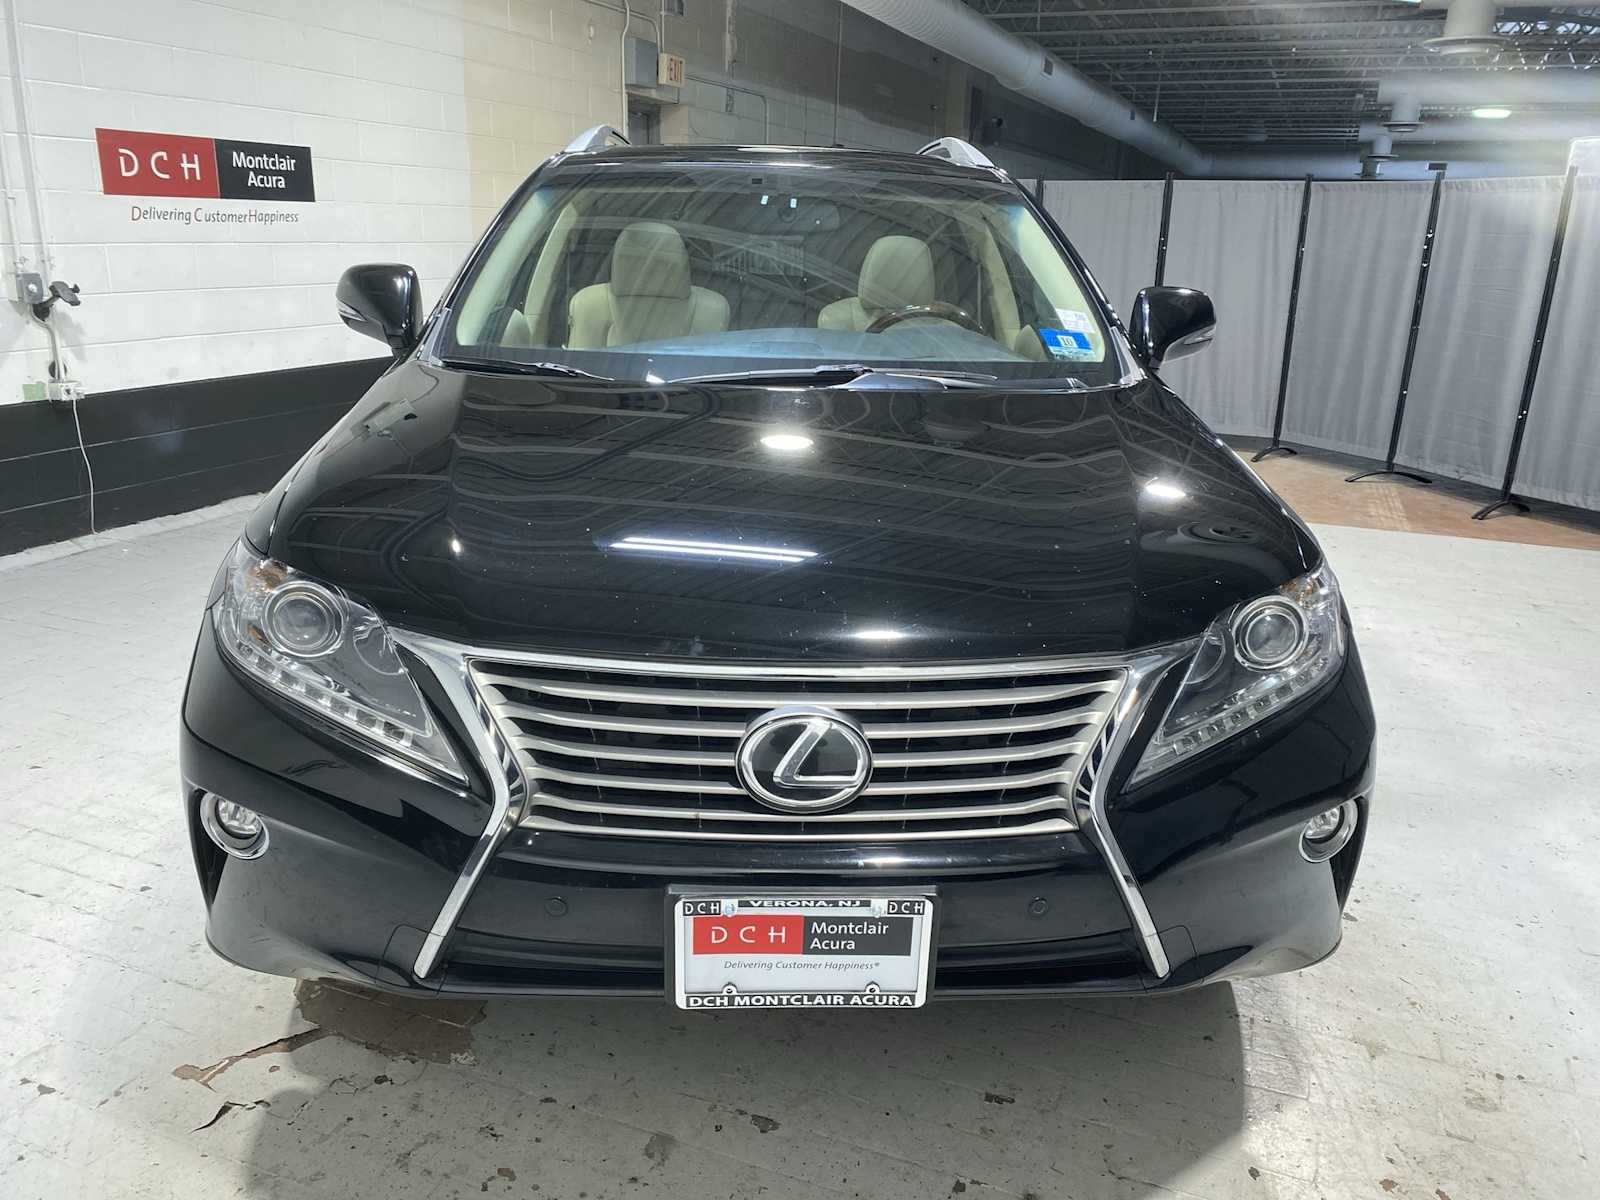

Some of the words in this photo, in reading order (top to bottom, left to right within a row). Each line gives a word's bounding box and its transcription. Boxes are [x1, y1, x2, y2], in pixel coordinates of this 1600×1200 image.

[118, 148, 201, 181] DCH
[232, 151, 297, 172] Montclair
[247, 171, 286, 189] Acura
[131, 206, 192, 225] Delivering
[684, 902, 720, 915] DCH
[838, 899, 861, 907] NJ
[889, 901, 924, 914] DCH
[711, 925, 786, 944] DCH
[811, 921, 889, 935] Montclair
[809, 937, 856, 950] Acura
[724, 960, 773, 971] Delivering
[775, 961, 821, 971] Customer
[688, 996, 729, 1008] DCH
[734, 994, 845, 1007] MONTCLAIR
[850, 994, 913, 1006] ACURA
